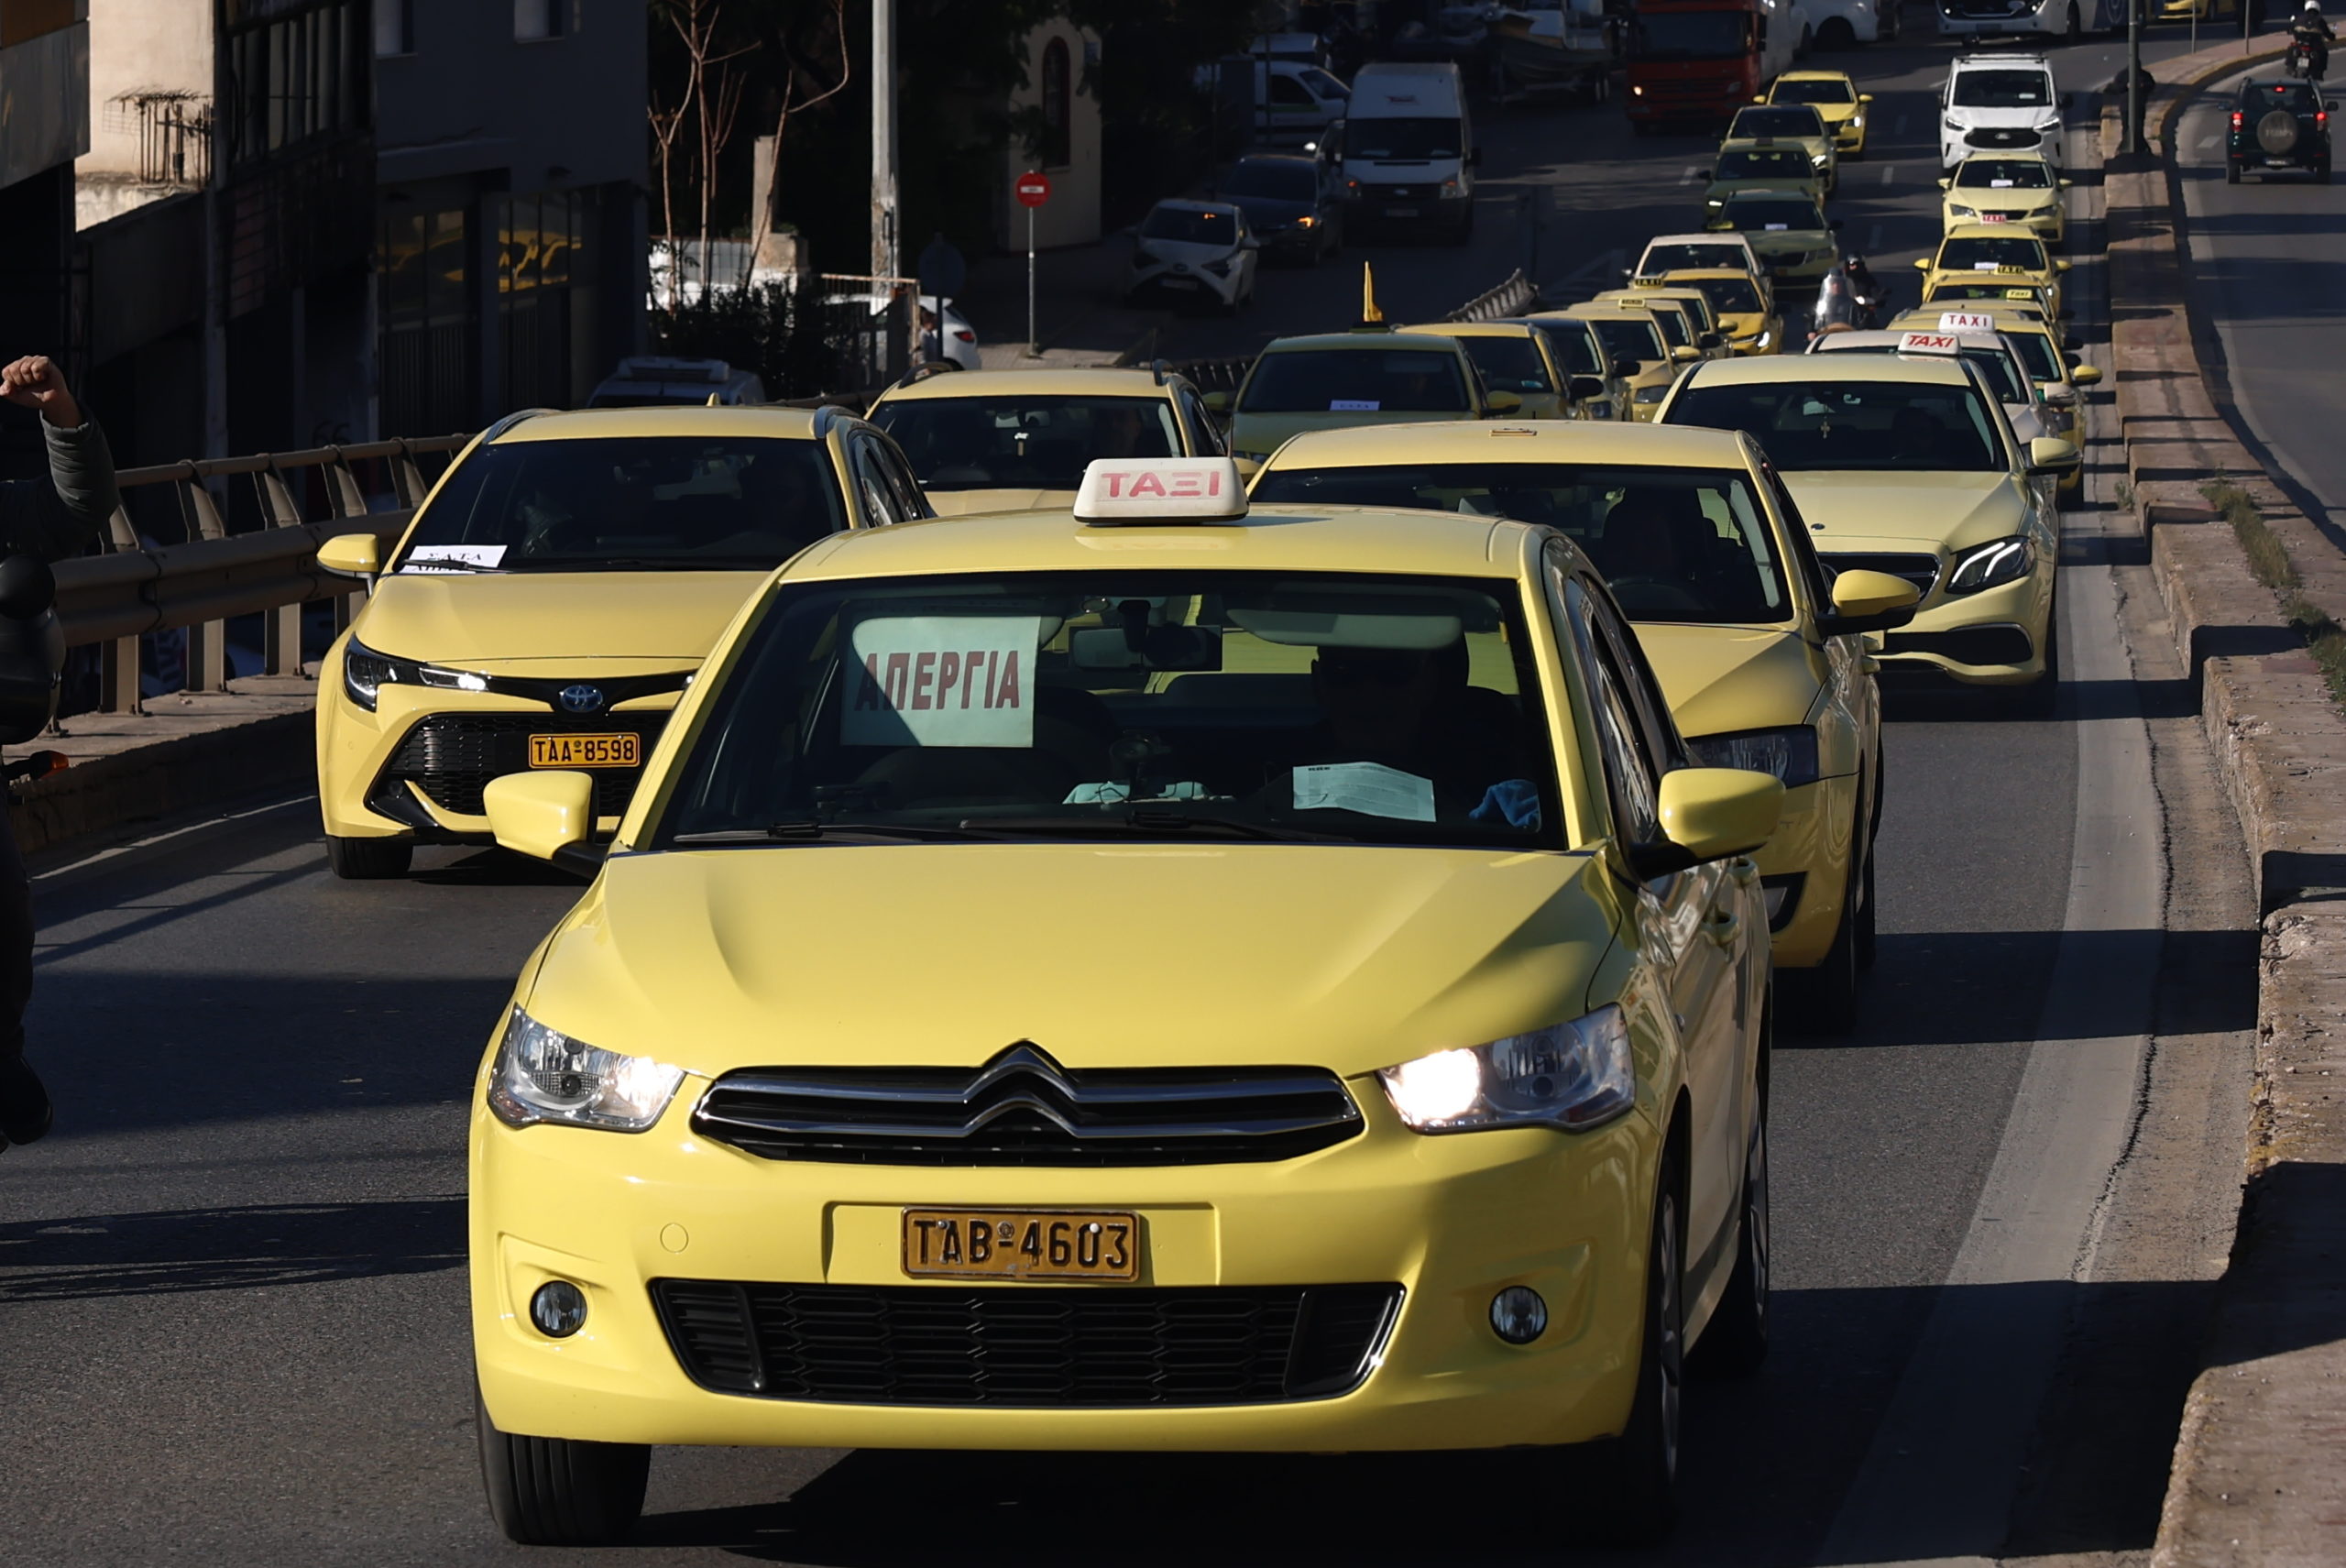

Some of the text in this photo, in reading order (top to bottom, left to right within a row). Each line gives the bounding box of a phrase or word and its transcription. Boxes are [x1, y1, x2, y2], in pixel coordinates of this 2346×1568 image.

[1948, 314, 1988, 327] TAXI
[1907, 334, 1956, 348] TAXI
[1101, 470, 1221, 499] ΤΑΞΙ
[853, 650, 1020, 711] ΑΠΕΡΓΙΑ
